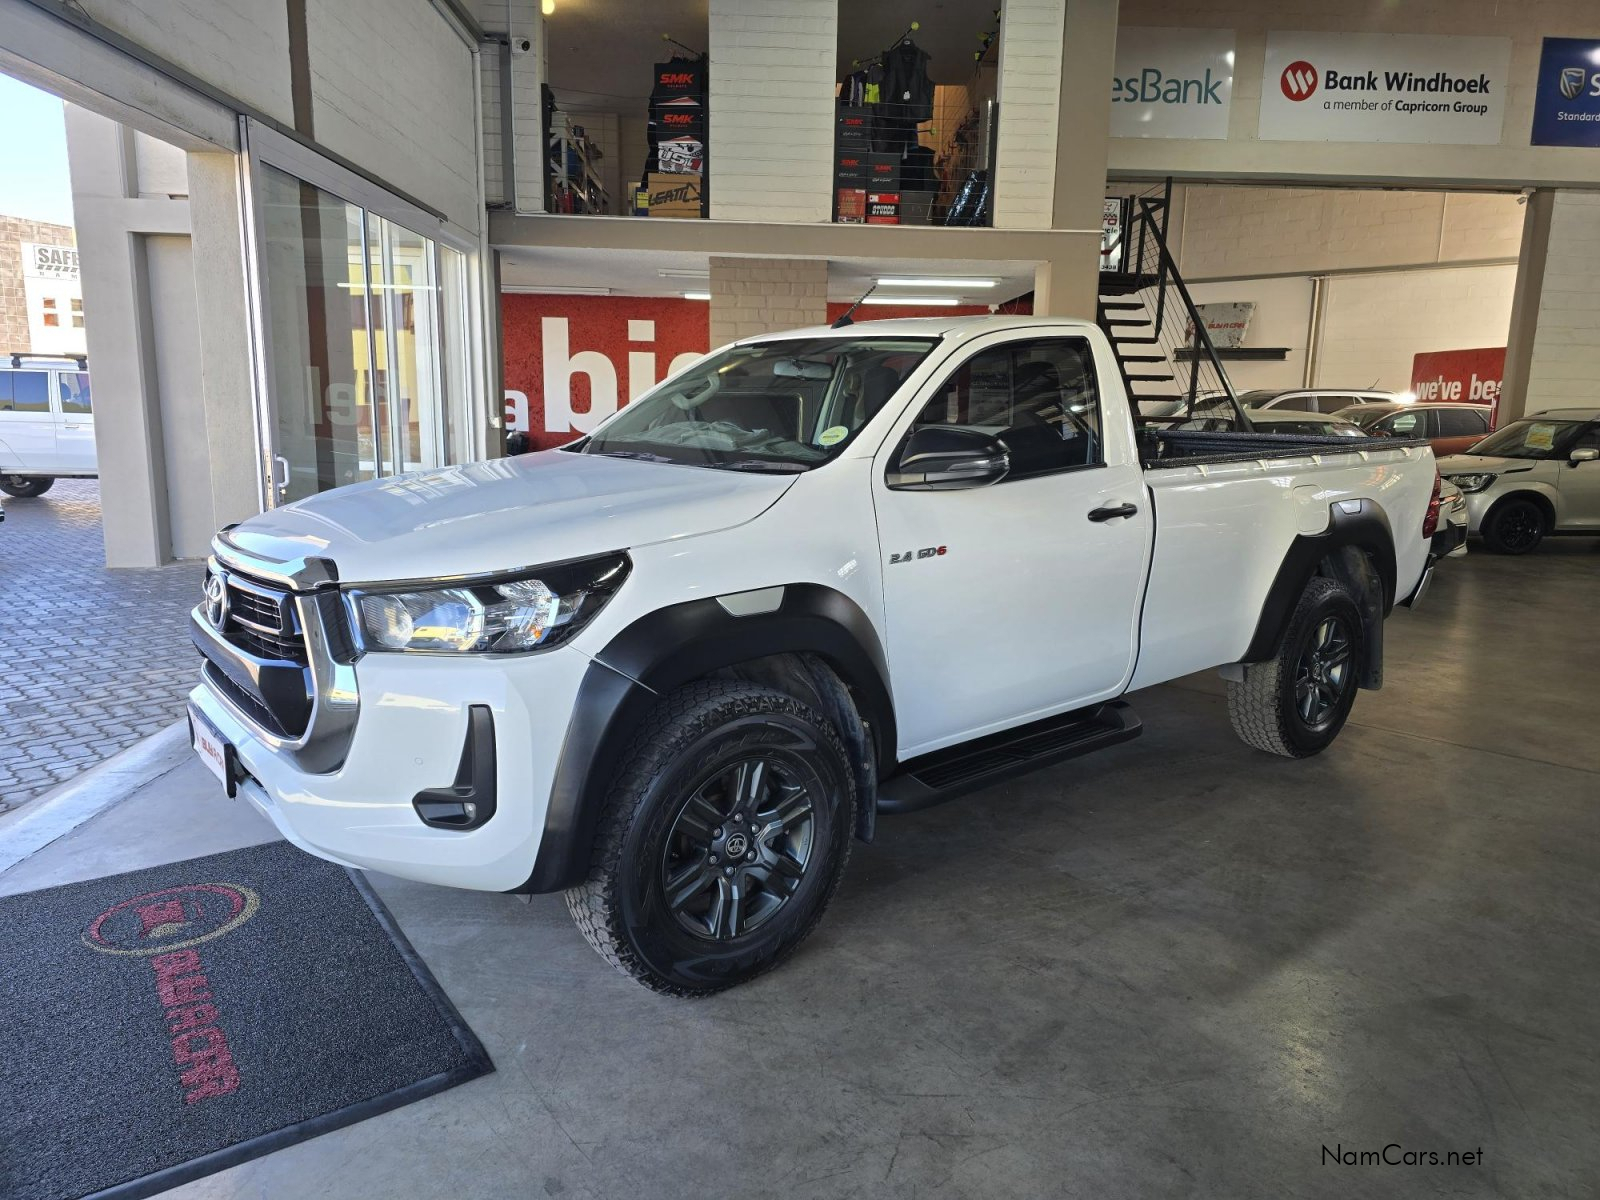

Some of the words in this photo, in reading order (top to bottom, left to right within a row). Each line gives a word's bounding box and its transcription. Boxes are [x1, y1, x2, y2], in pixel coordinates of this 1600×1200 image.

[660, 73, 694, 84] SMK
[1324, 70, 1378, 91] Bank
[1384, 71, 1490, 94] Windhoek
[1323, 101, 1331, 110] a
[1333, 99, 1379, 111] member
[1381, 99, 1394, 112] of
[1395, 100, 1450, 114] Capricorn
[1453, 101, 1488, 116] Group
[663, 114, 694, 124] SMK
[1416, 375, 1462, 400] we've
